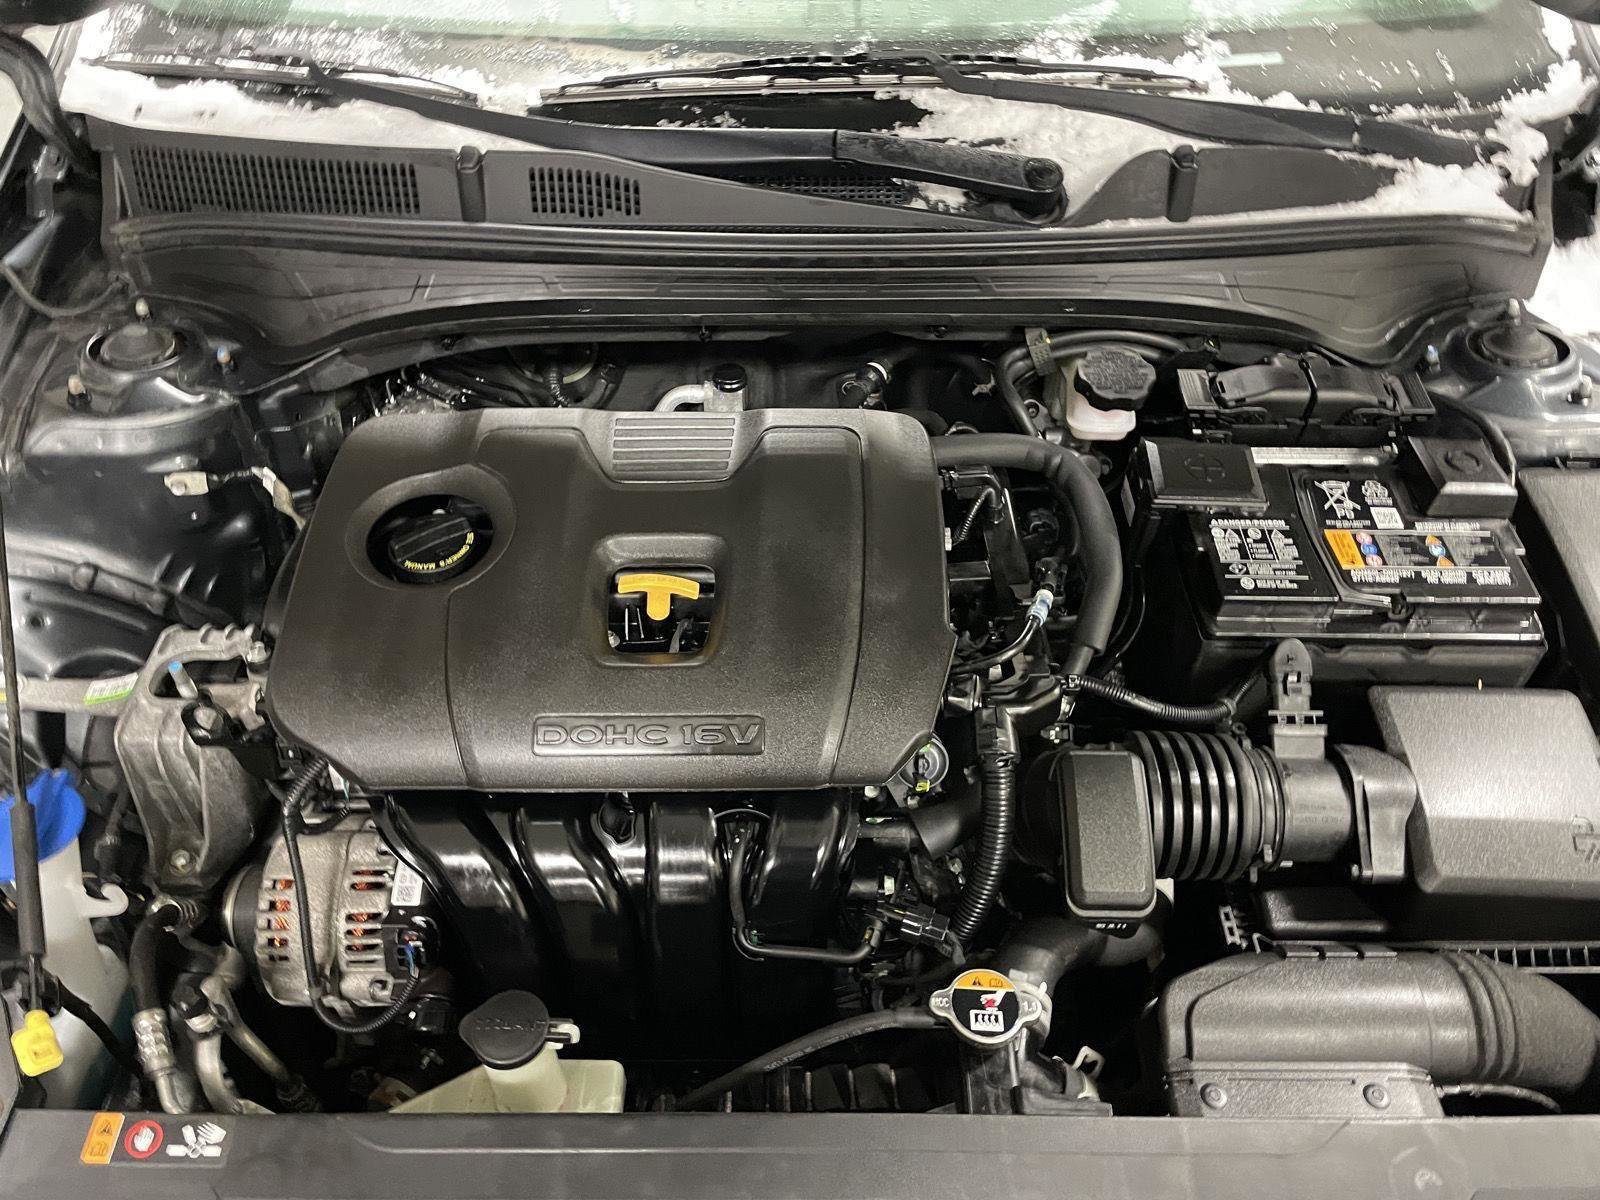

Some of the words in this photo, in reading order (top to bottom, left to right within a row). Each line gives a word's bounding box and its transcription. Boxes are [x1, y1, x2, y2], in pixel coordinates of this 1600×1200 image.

[403, 559, 436, 571] MANUAL
[535, 723, 669, 746] DOHC
[681, 723, 761, 746] 16V
